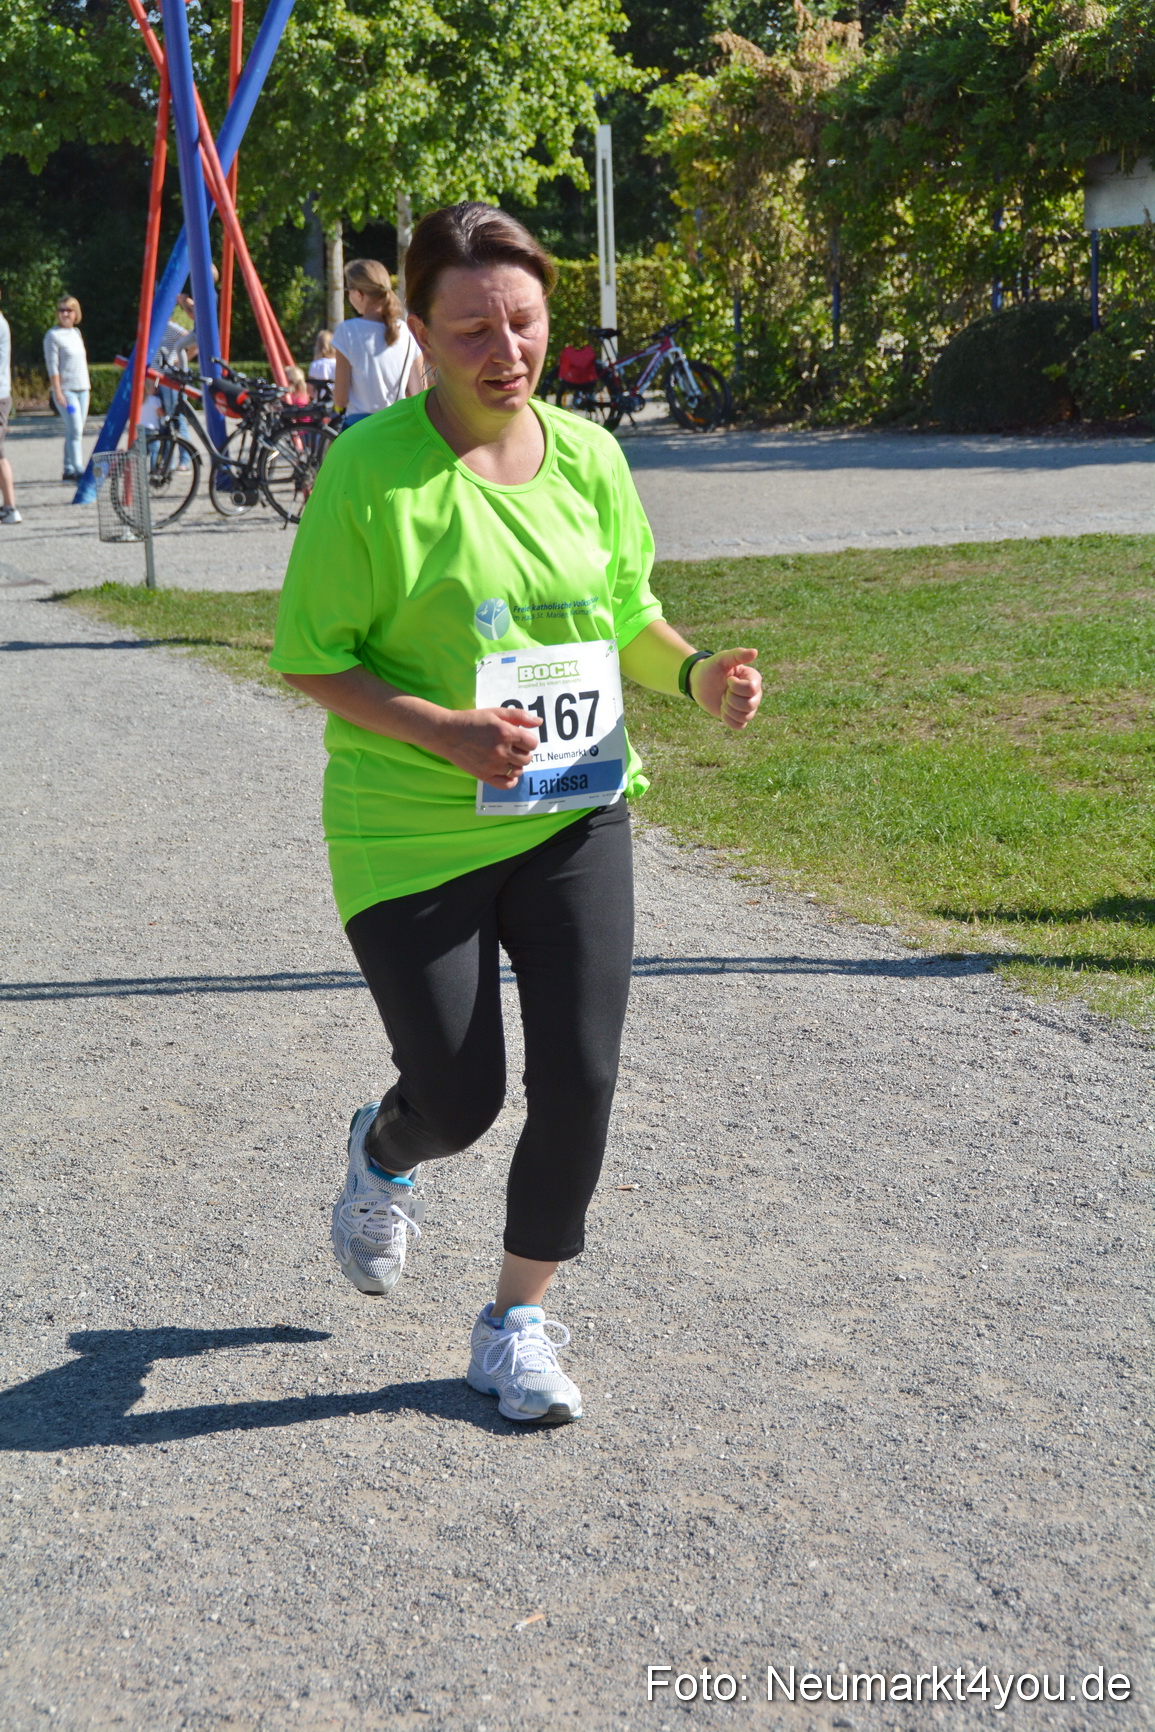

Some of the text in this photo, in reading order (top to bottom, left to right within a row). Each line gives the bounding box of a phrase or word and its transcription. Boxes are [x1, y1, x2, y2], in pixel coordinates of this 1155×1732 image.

[513, 604, 531, 613] Freie
[531, 601, 572, 611] katholische
[518, 660, 580, 682] BOCK
[518, 681, 539, 689] inspired
[539, 680, 546, 688] by
[529, 752, 546, 764] TL
[549, 748, 587, 761] Neumarkt
[529, 773, 589, 797] Larissa
